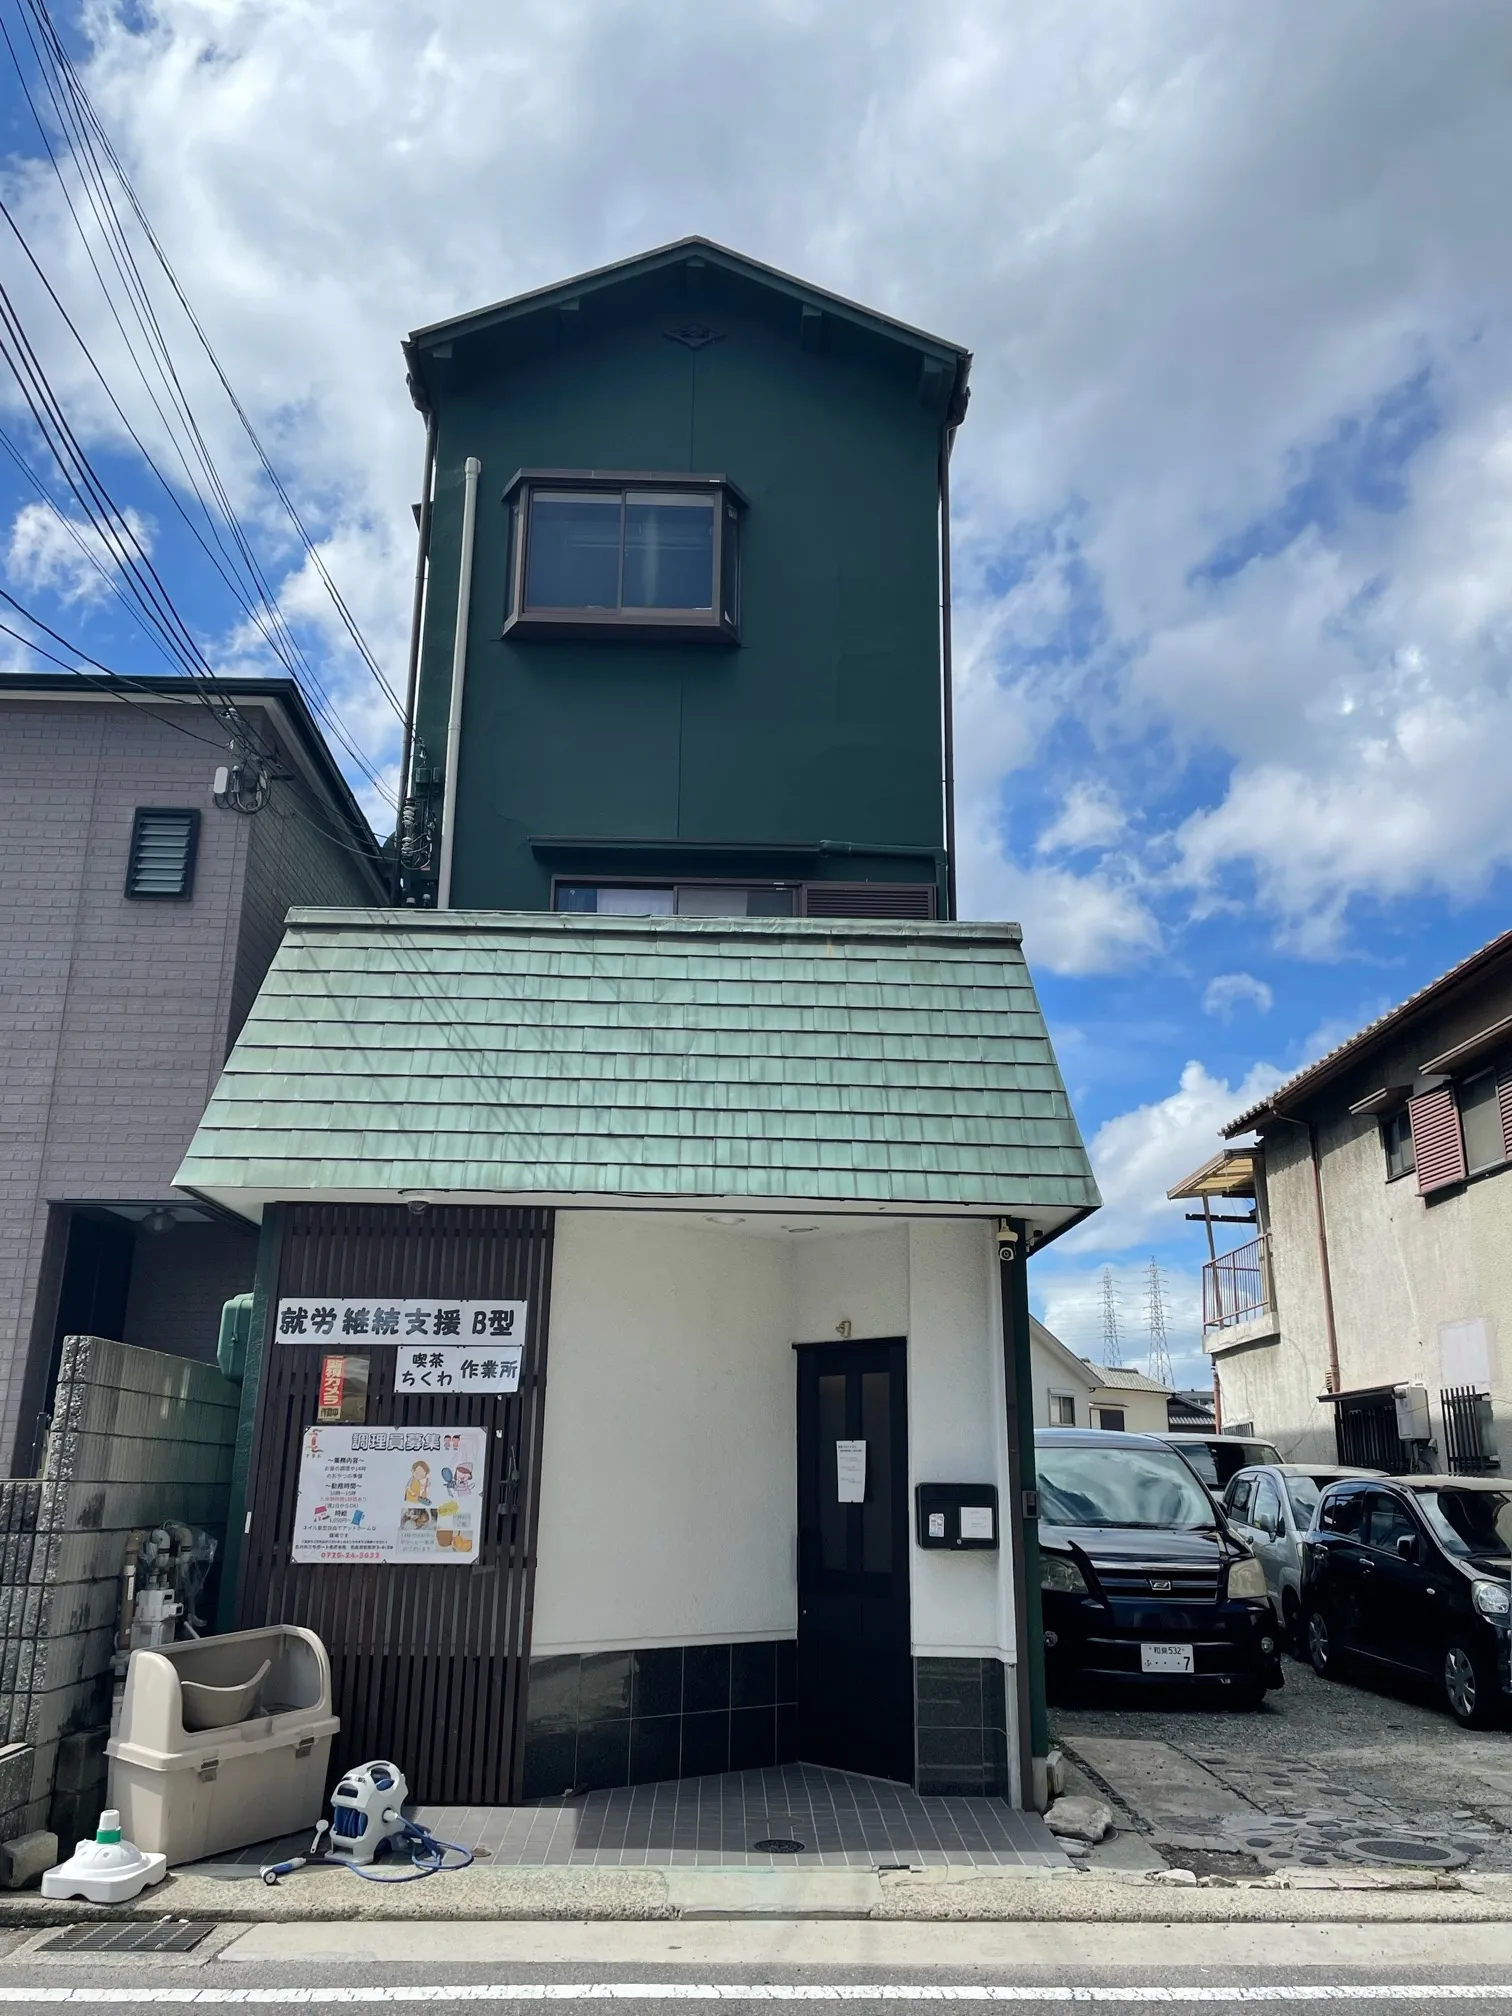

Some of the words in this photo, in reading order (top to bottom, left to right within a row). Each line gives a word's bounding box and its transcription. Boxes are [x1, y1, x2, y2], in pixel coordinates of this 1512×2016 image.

[412, 1352, 444, 1368] 喫茶
[460, 1359, 518, 1379] 作業所
[401, 1370, 453, 1387] ちくわ
[351, 1432, 441, 1451] 調理員募集
